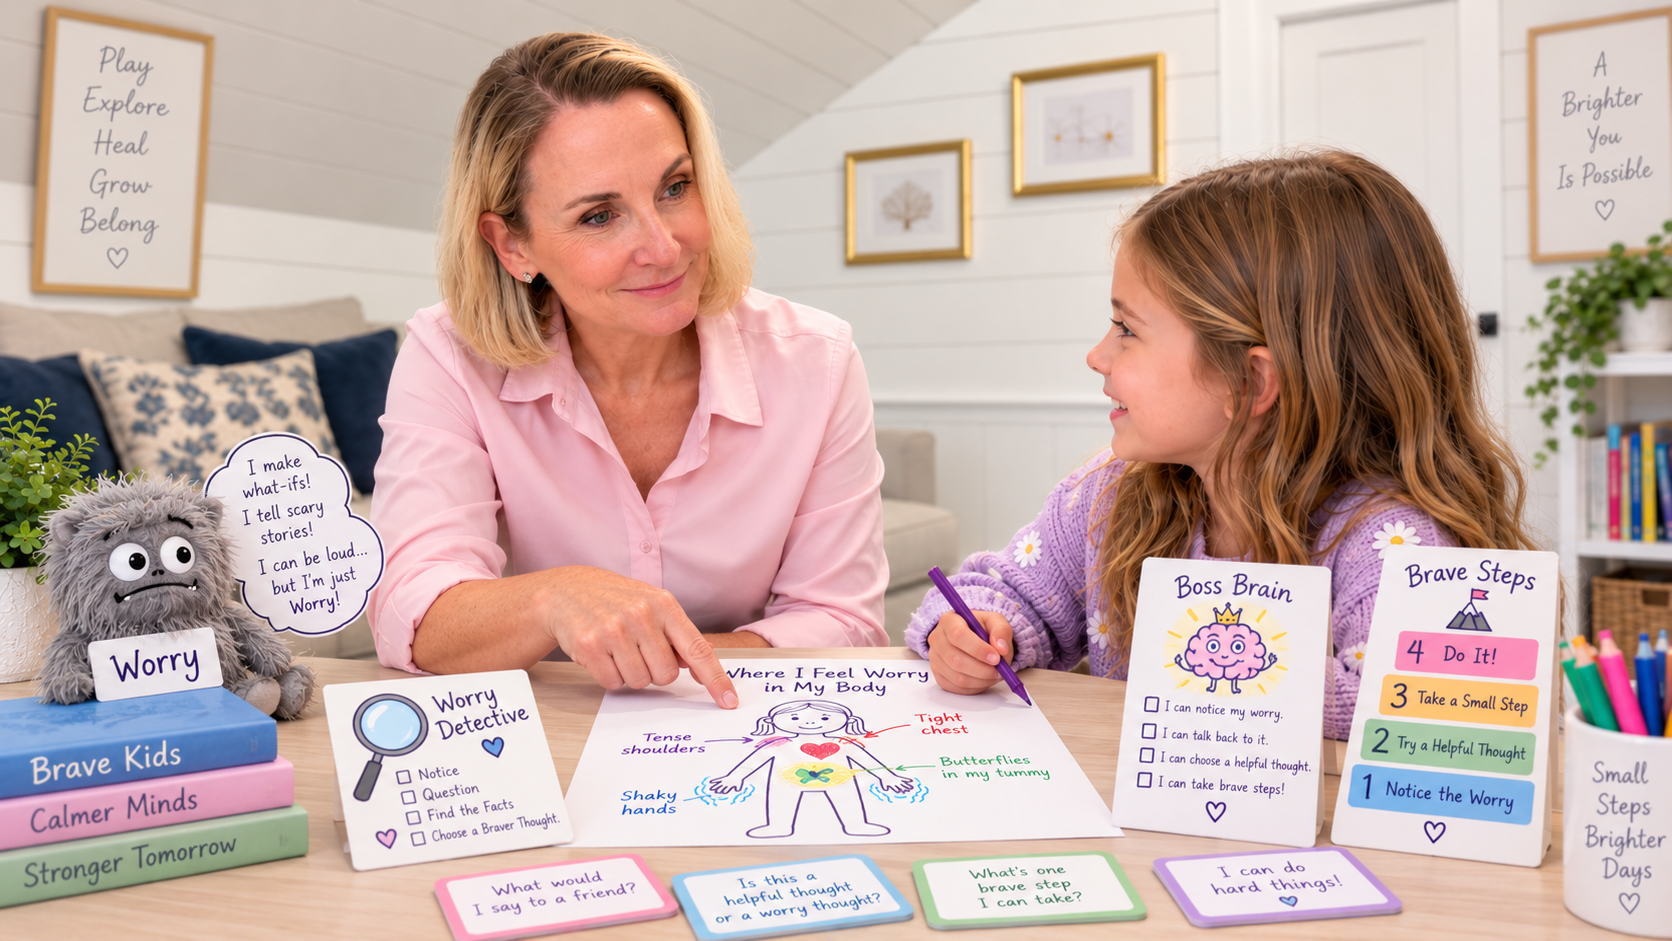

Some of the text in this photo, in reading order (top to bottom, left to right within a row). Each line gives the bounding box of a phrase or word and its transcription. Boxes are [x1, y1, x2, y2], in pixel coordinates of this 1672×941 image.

[99, 46, 154, 86] Play
[1593, 50, 1607, 77] A
[82, 86, 170, 122] Explore
[1562, 86, 1643, 121] Brighter
[94, 129, 149, 155] Heal
[1587, 125, 1622, 154] You
[89, 168, 153, 199] Grow
[1557, 156, 1654, 190] Is Possible
[80, 207, 160, 244] Belong
[248, 455, 302, 476] I make
[243, 474, 310, 498] what-ifs!
[242, 503, 324, 526] I tell scary
[261, 520, 313, 544] stories!
[258, 542, 368, 575] I can be loud...
[272, 567, 357, 595] but I'm just
[1174, 573, 1293, 603] Boss Brain
[1405, 560, 1536, 594] Brave Steps
[289, 591, 340, 614] Worry!
[1407, 640, 1496, 665] 4 Do It!
[109, 648, 200, 683] Worry
[795, 667, 804, 678] I
[813, 667, 854, 678] Feel
[864, 668, 929, 682] Worry
[765, 681, 887, 696] in My Body
[1390, 683, 1528, 717] 3 Take a Small Step
[432, 689, 498, 713] Worry
[1165, 700, 1283, 723] I can notice my worry.
[435, 708, 529, 740] Detective
[915, 713, 963, 725] Tight
[921, 725, 969, 735] chest
[643, 733, 692, 742] Tense
[1162, 727, 1268, 746] I can talk back to it.
[1372, 727, 1526, 764] 2 Try a Helpful Thought
[621, 744, 706, 755] shoulders
[939, 755, 1030, 766] Butterflies
[30, 740, 182, 785] Brave Kids
[418, 766, 460, 781] Notice
[1160, 751, 1311, 775] I can choose a helpful thought.
[1592, 761, 1649, 784] Small
[942, 769, 1050, 781] in my tummy
[1158, 775, 1285, 799] I can take brave steps!
[422, 784, 479, 801] Question
[621, 791, 677, 803] Shaky
[1362, 774, 1514, 814] 1 Notice the Worry
[30, 786, 198, 833] Calmer Minds
[427, 799, 514, 821] Find the Facts
[622, 804, 677, 815] hands
[1596, 792, 1651, 823] Steps
[432, 829, 468, 842] Choose
[481, 822, 514, 835] Braver
[517, 813, 560, 830] Thought.
[1585, 824, 1666, 857] Brighter
[24, 838, 237, 888] Stronger Tomorrow
[969, 866, 1066, 879] What's one
[1217, 861, 1306, 878] I can do
[1602, 857, 1652, 888] Days
[491, 871, 603, 896] What would
[737, 873, 817, 889] Is this a
[978, 880, 1071, 893] brave step
[1211, 874, 1343, 895] hard things!
[473, 882, 636, 916] I say to a friend?
[724, 881, 853, 907] helpful thought
[978, 892, 1082, 909] I can take?
[716, 893, 881, 924] or a worry thought?
